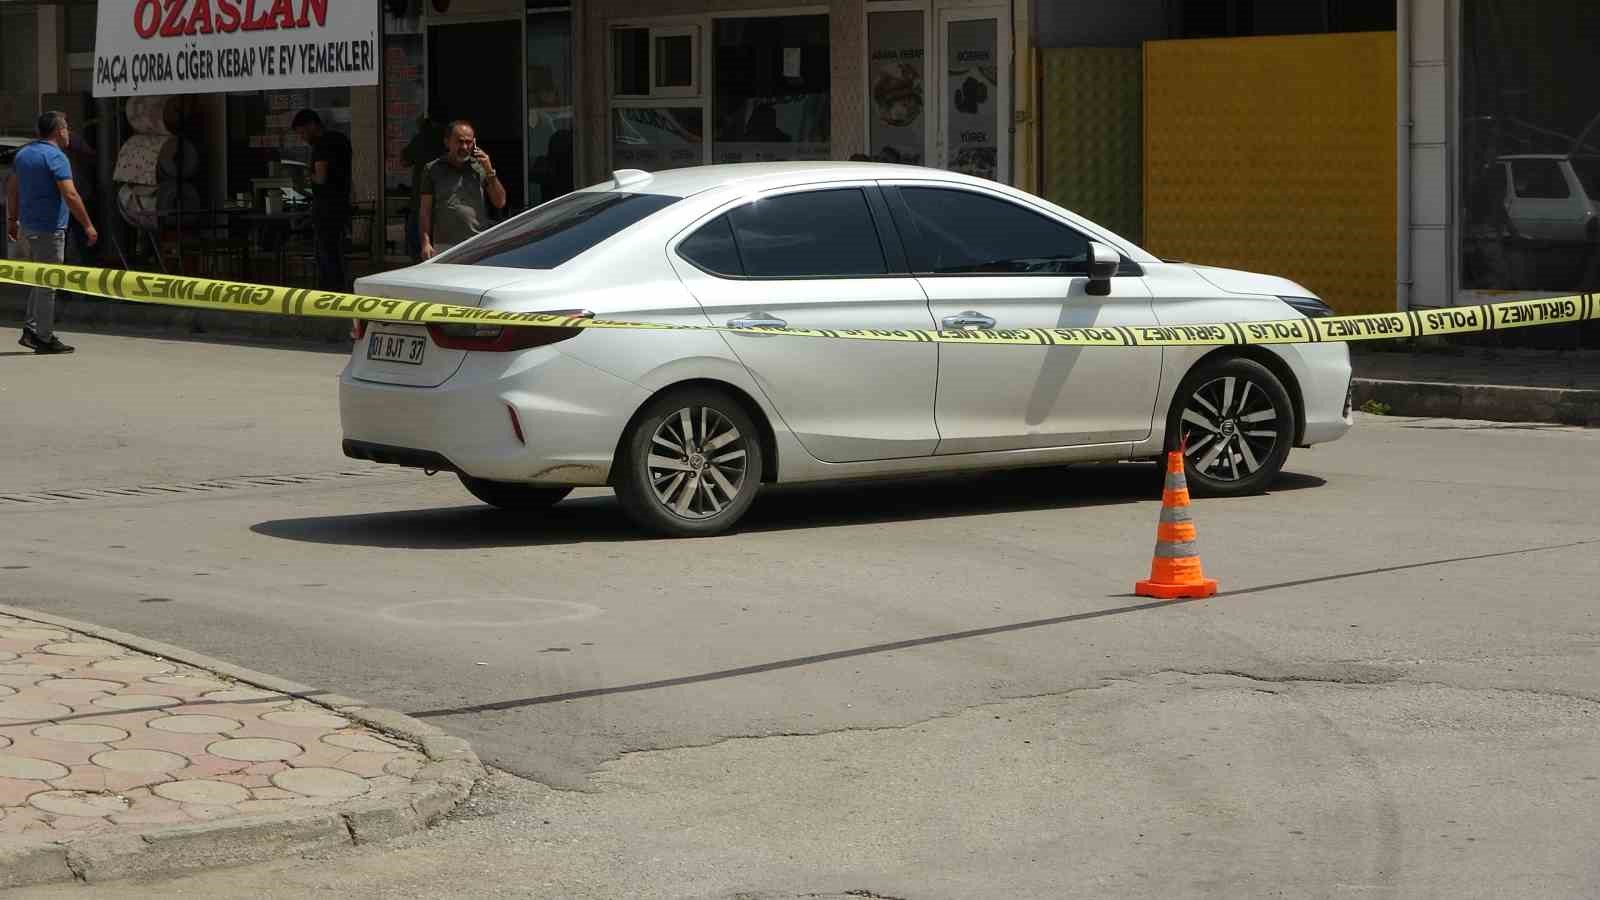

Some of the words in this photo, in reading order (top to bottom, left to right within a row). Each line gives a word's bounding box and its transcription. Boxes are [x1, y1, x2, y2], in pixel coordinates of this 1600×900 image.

[97, 56, 128, 92] PAÇA
[132, 53, 173, 91] ÇORBA
[176, 43, 214, 80] CİĞER
[217, 48, 256, 78] KEBAP
[259, 45, 275, 76] VE
[279, 44, 296, 75] EV
[300, 31, 375, 74] YEMEKLERİ
[409, 340, 425, 361] 37
